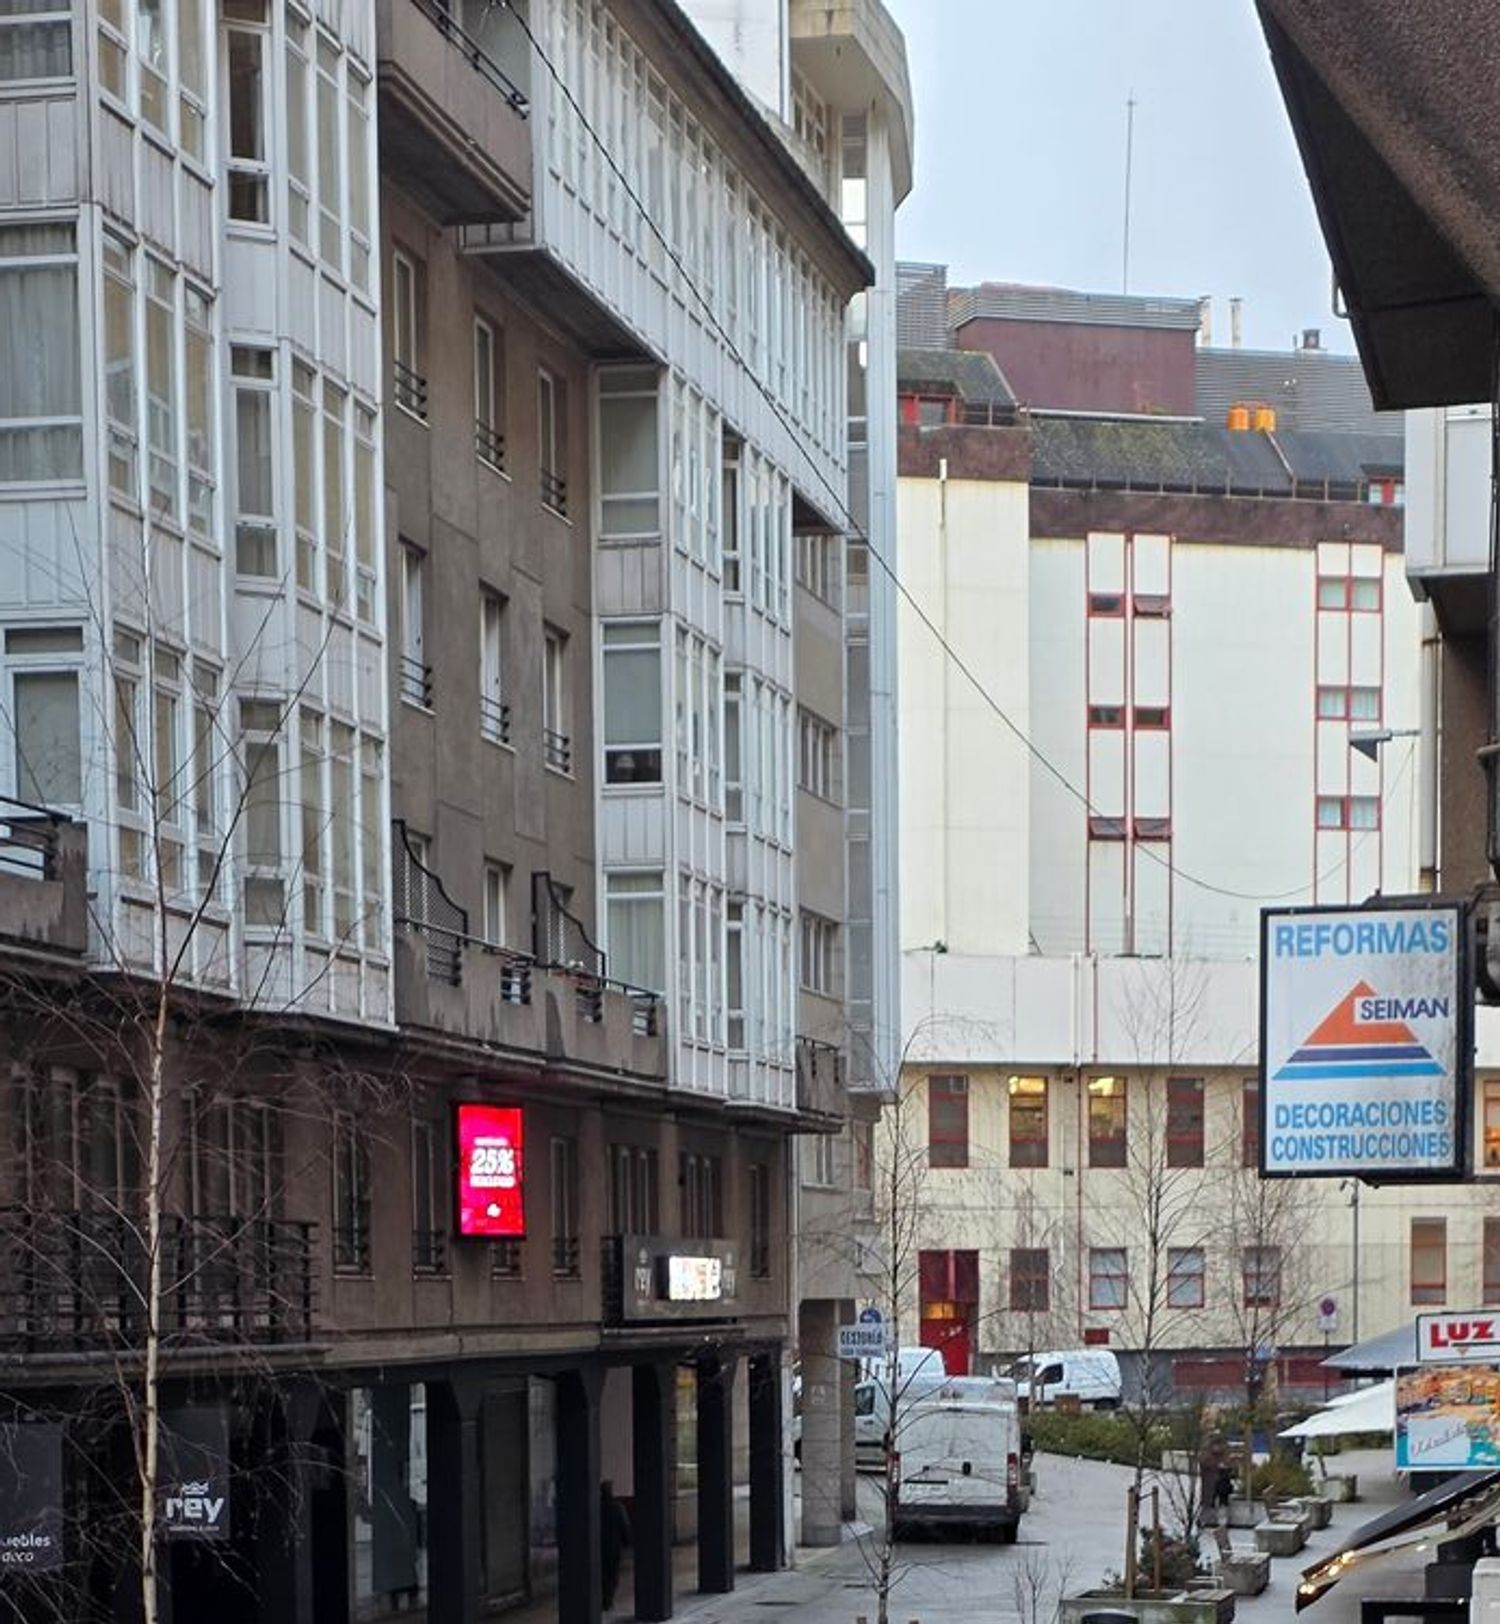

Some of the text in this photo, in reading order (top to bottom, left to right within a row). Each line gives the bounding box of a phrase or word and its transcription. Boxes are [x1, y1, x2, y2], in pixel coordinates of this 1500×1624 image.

[1275, 920, 1449, 957] REFORMAS
[1361, 998, 1449, 1020] SEIMAN
[1274, 1100, 1448, 1129] DECORACIONES
[1272, 1132, 1450, 1161] CONSTRUCCIONES
[470, 1148, 514, 1174] 25%
[1430, 1320, 1495, 1348] LUZ
[166, 1498, 225, 1523] rey
